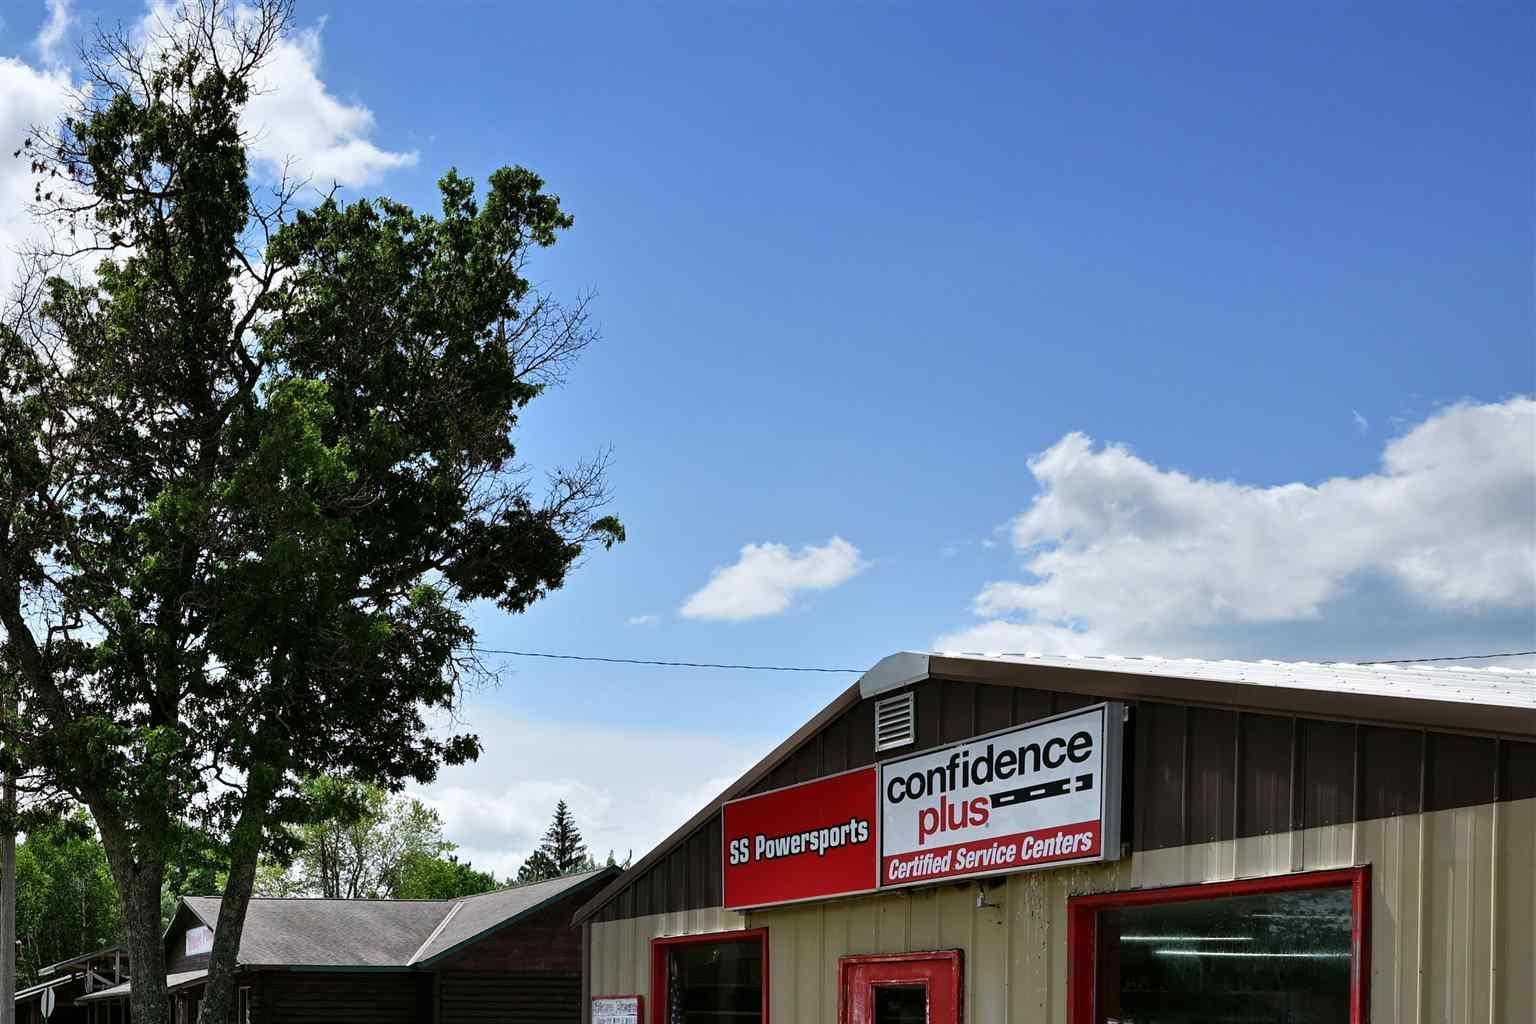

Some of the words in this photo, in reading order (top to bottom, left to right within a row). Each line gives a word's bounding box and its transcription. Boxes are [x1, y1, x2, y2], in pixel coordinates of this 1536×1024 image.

[887, 731, 1093, 803] confidence
[729, 838, 750, 865] SS
[755, 818, 868, 856] Powersports
[918, 795, 989, 845] plus
[888, 853, 951, 881] Certified
[955, 843, 1016, 871] Service
[1021, 830, 1094, 861] Centers
